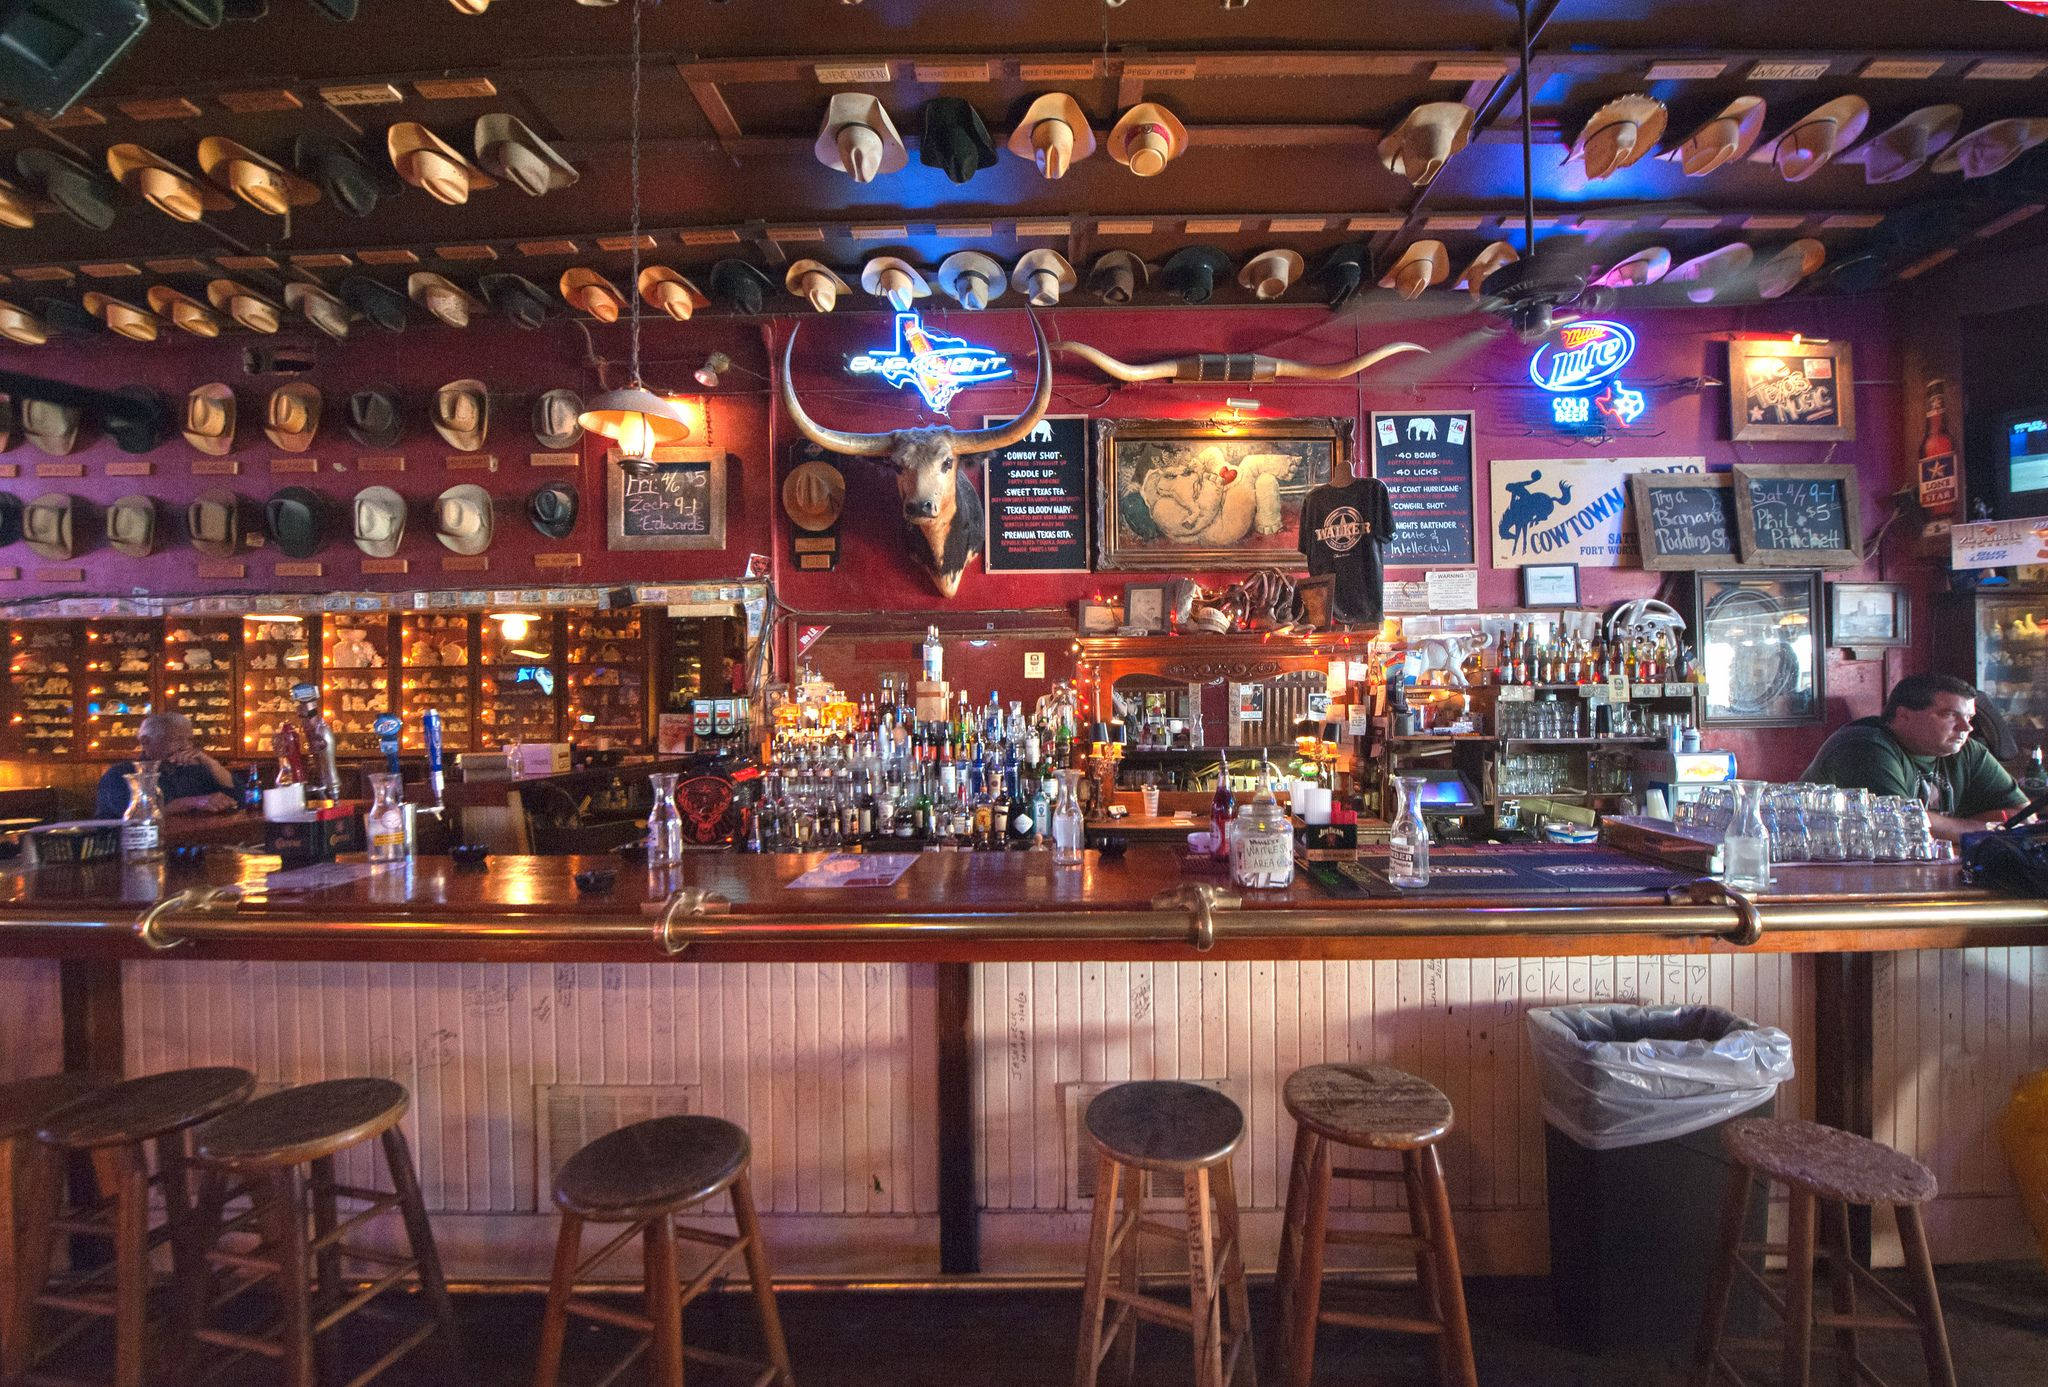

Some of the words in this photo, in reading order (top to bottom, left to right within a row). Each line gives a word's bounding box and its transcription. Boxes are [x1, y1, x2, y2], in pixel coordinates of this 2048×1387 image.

[1552, 397, 1589, 410] COLD
[1555, 409, 1588, 422] BEER
[1006, 451, 1037, 460] COWBOY
[1039, 451, 1060, 460] SHOT
[1414, 451, 1437, 459] BOMB
[1010, 470, 1039, 478] SADDLE
[1413, 468, 1438, 476] LICKS
[661, 471, 681, 492] 4/6
[1925, 479, 1951, 491] LONE
[1006, 488, 1031, 497] SWEET
[1032, 488, 1053, 496] TEXAS
[1053, 487, 1065, 496] TEA
[1423, 485, 1459, 493] HURRICANE
[1752, 482, 1784, 503] Sat
[1786, 483, 1807, 506] 4/7
[1809, 482, 1836, 503] 9-1
[1650, 489, 1675, 510] Try
[1925, 489, 1951, 502] STAR
[1006, 506, 1027, 515] TEXAS
[1027, 506, 1053, 515] BLOODY
[1053, 505, 1072, 514] MARY
[1393, 502, 1425, 510] COWGIRL
[1530, 486, 1627, 554] COWTOWN
[1653, 507, 1725, 527] Banana
[641, 514, 705, 531] Edwards
[1420, 521, 1457, 529] BARTENDER
[1004, 531, 1036, 540] PREMIUM
[1036, 530, 1056, 539] TEXAS
[1056, 530, 1072, 539] RITA
[1314, 521, 1371, 541] WALKER
[1655, 527, 1711, 554] Pudding
[1580, 546, 1604, 555] FORT
[1976, 549, 2008, 557] BUD
[1968, 554, 2009, 562] LIGHT
